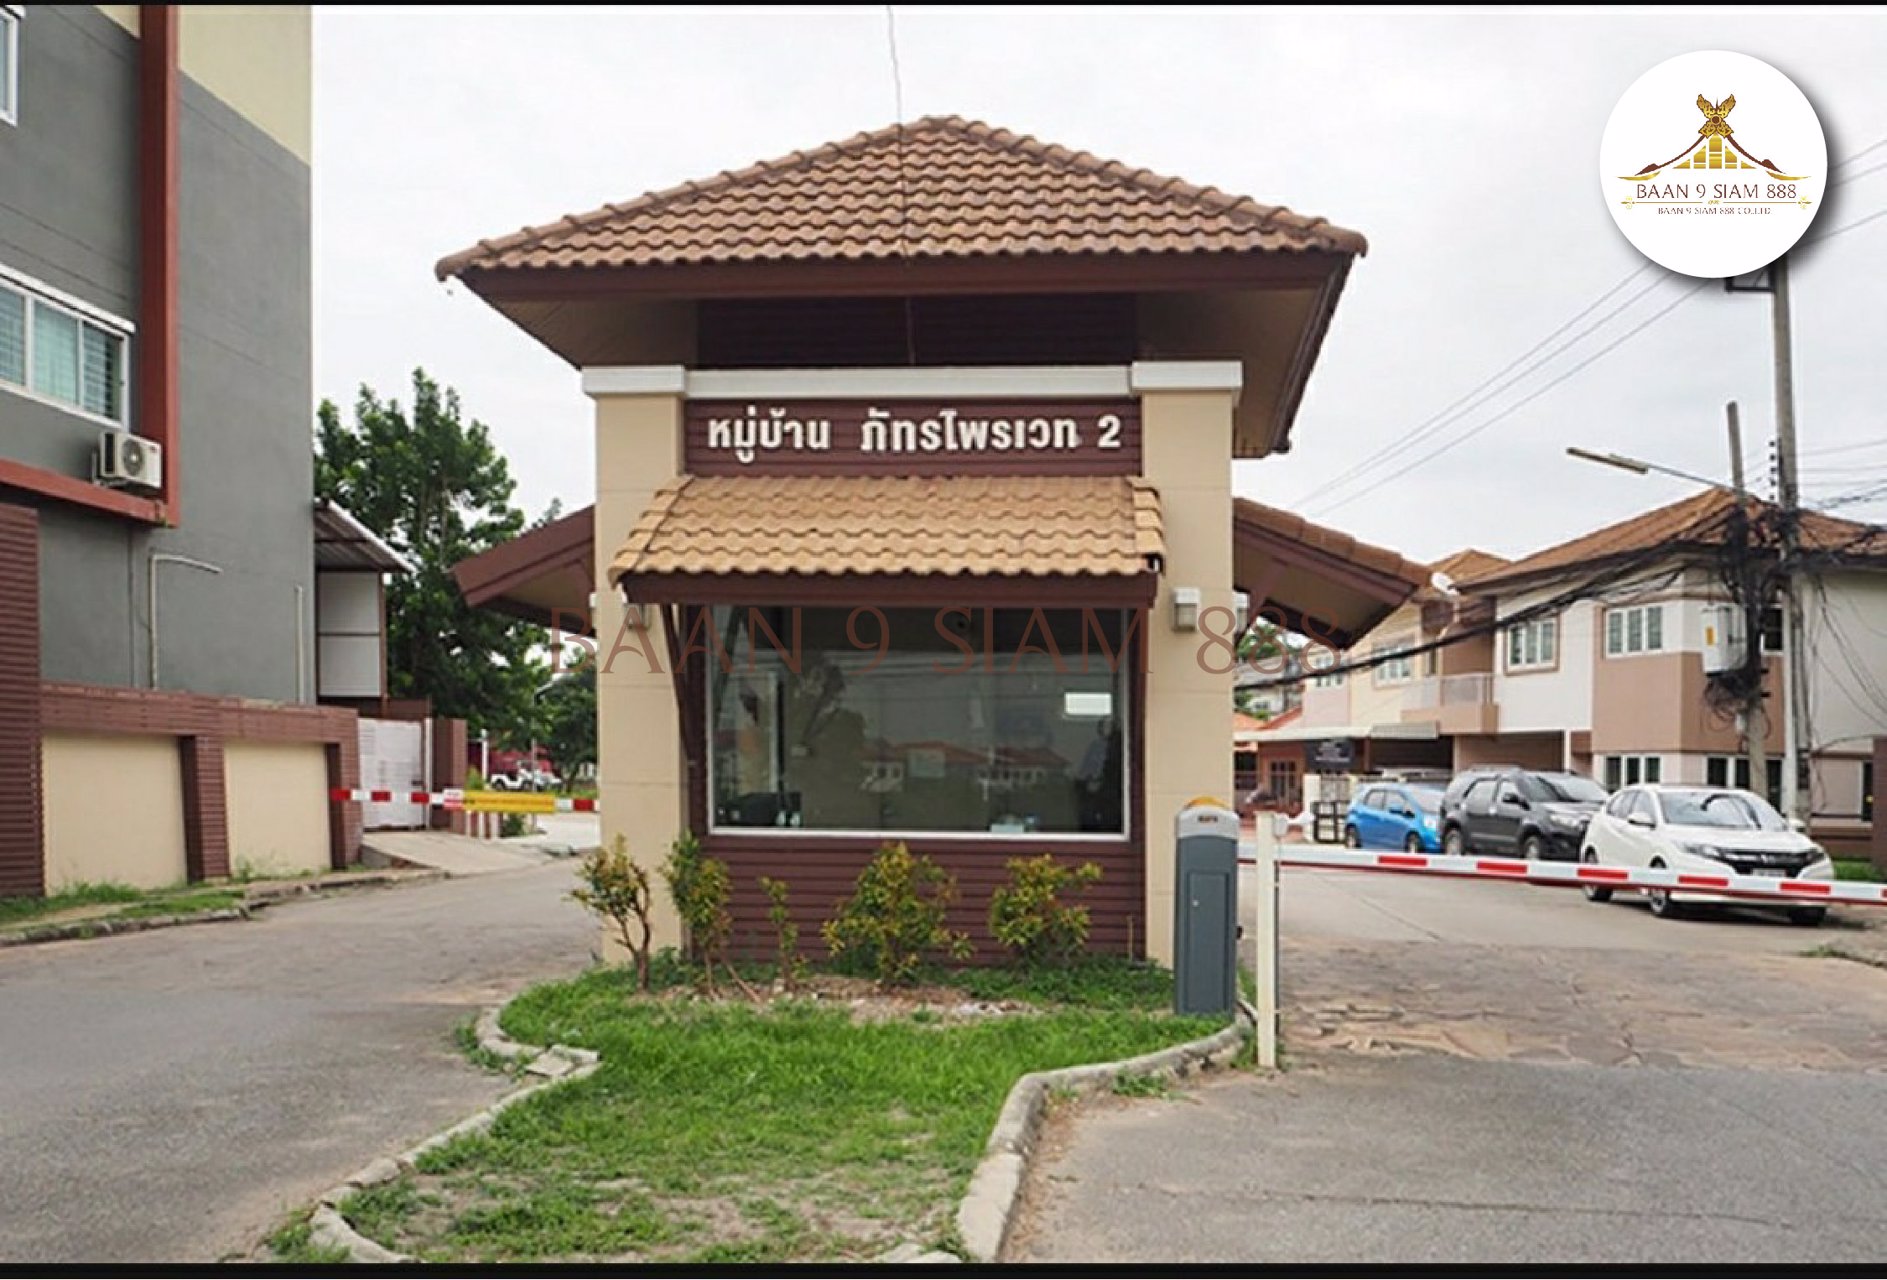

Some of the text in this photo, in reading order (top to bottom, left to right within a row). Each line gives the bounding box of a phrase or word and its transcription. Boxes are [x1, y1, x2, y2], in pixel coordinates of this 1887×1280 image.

[707, 404, 830, 464] หมู่บ้าน
[1098, 415, 1121, 448] 2
